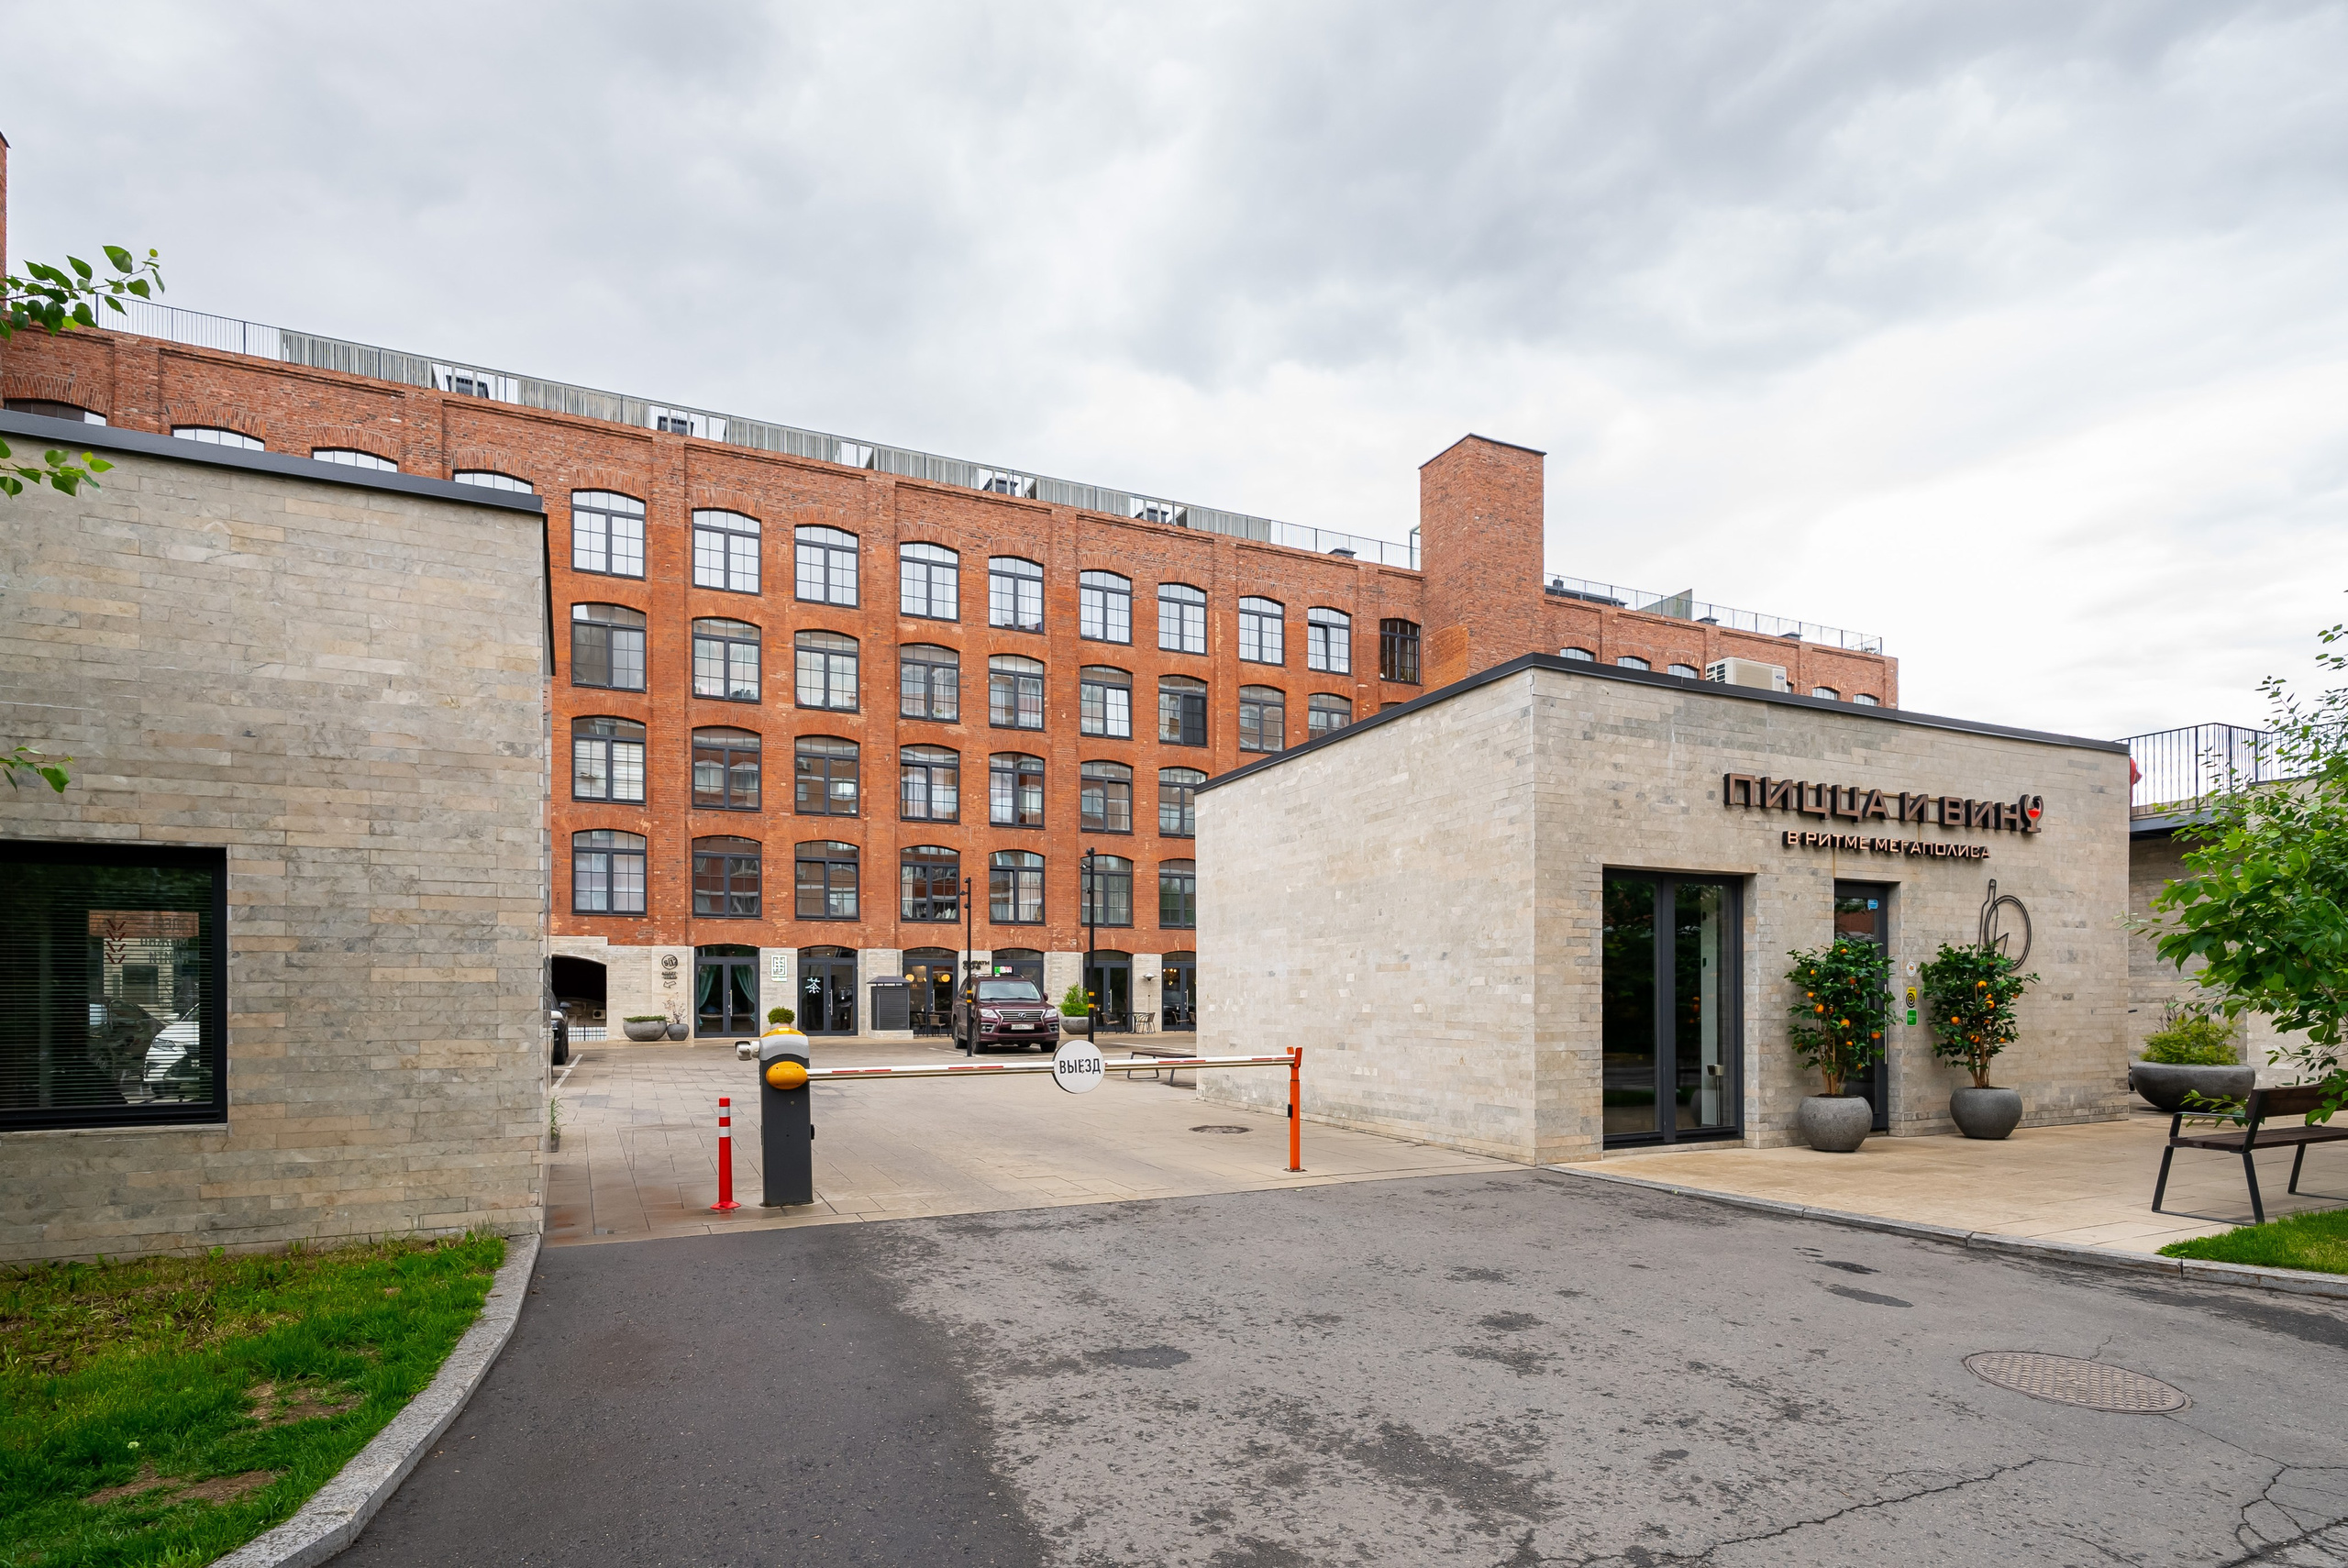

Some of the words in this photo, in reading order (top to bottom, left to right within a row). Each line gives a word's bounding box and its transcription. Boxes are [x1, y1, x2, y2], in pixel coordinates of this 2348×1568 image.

[1723, 772, 1891, 823] ПИЦЦА
[1899, 791, 1929, 823] И
[1782, 831, 1800, 845] В
[1800, 832, 1869, 851] РИТМЕ
[1870, 837, 1991, 859] МЕГАПОЛИСА
[804, 977, 821, 994] 茶
[1058, 1058, 1102, 1075] ВЫЕЗД
